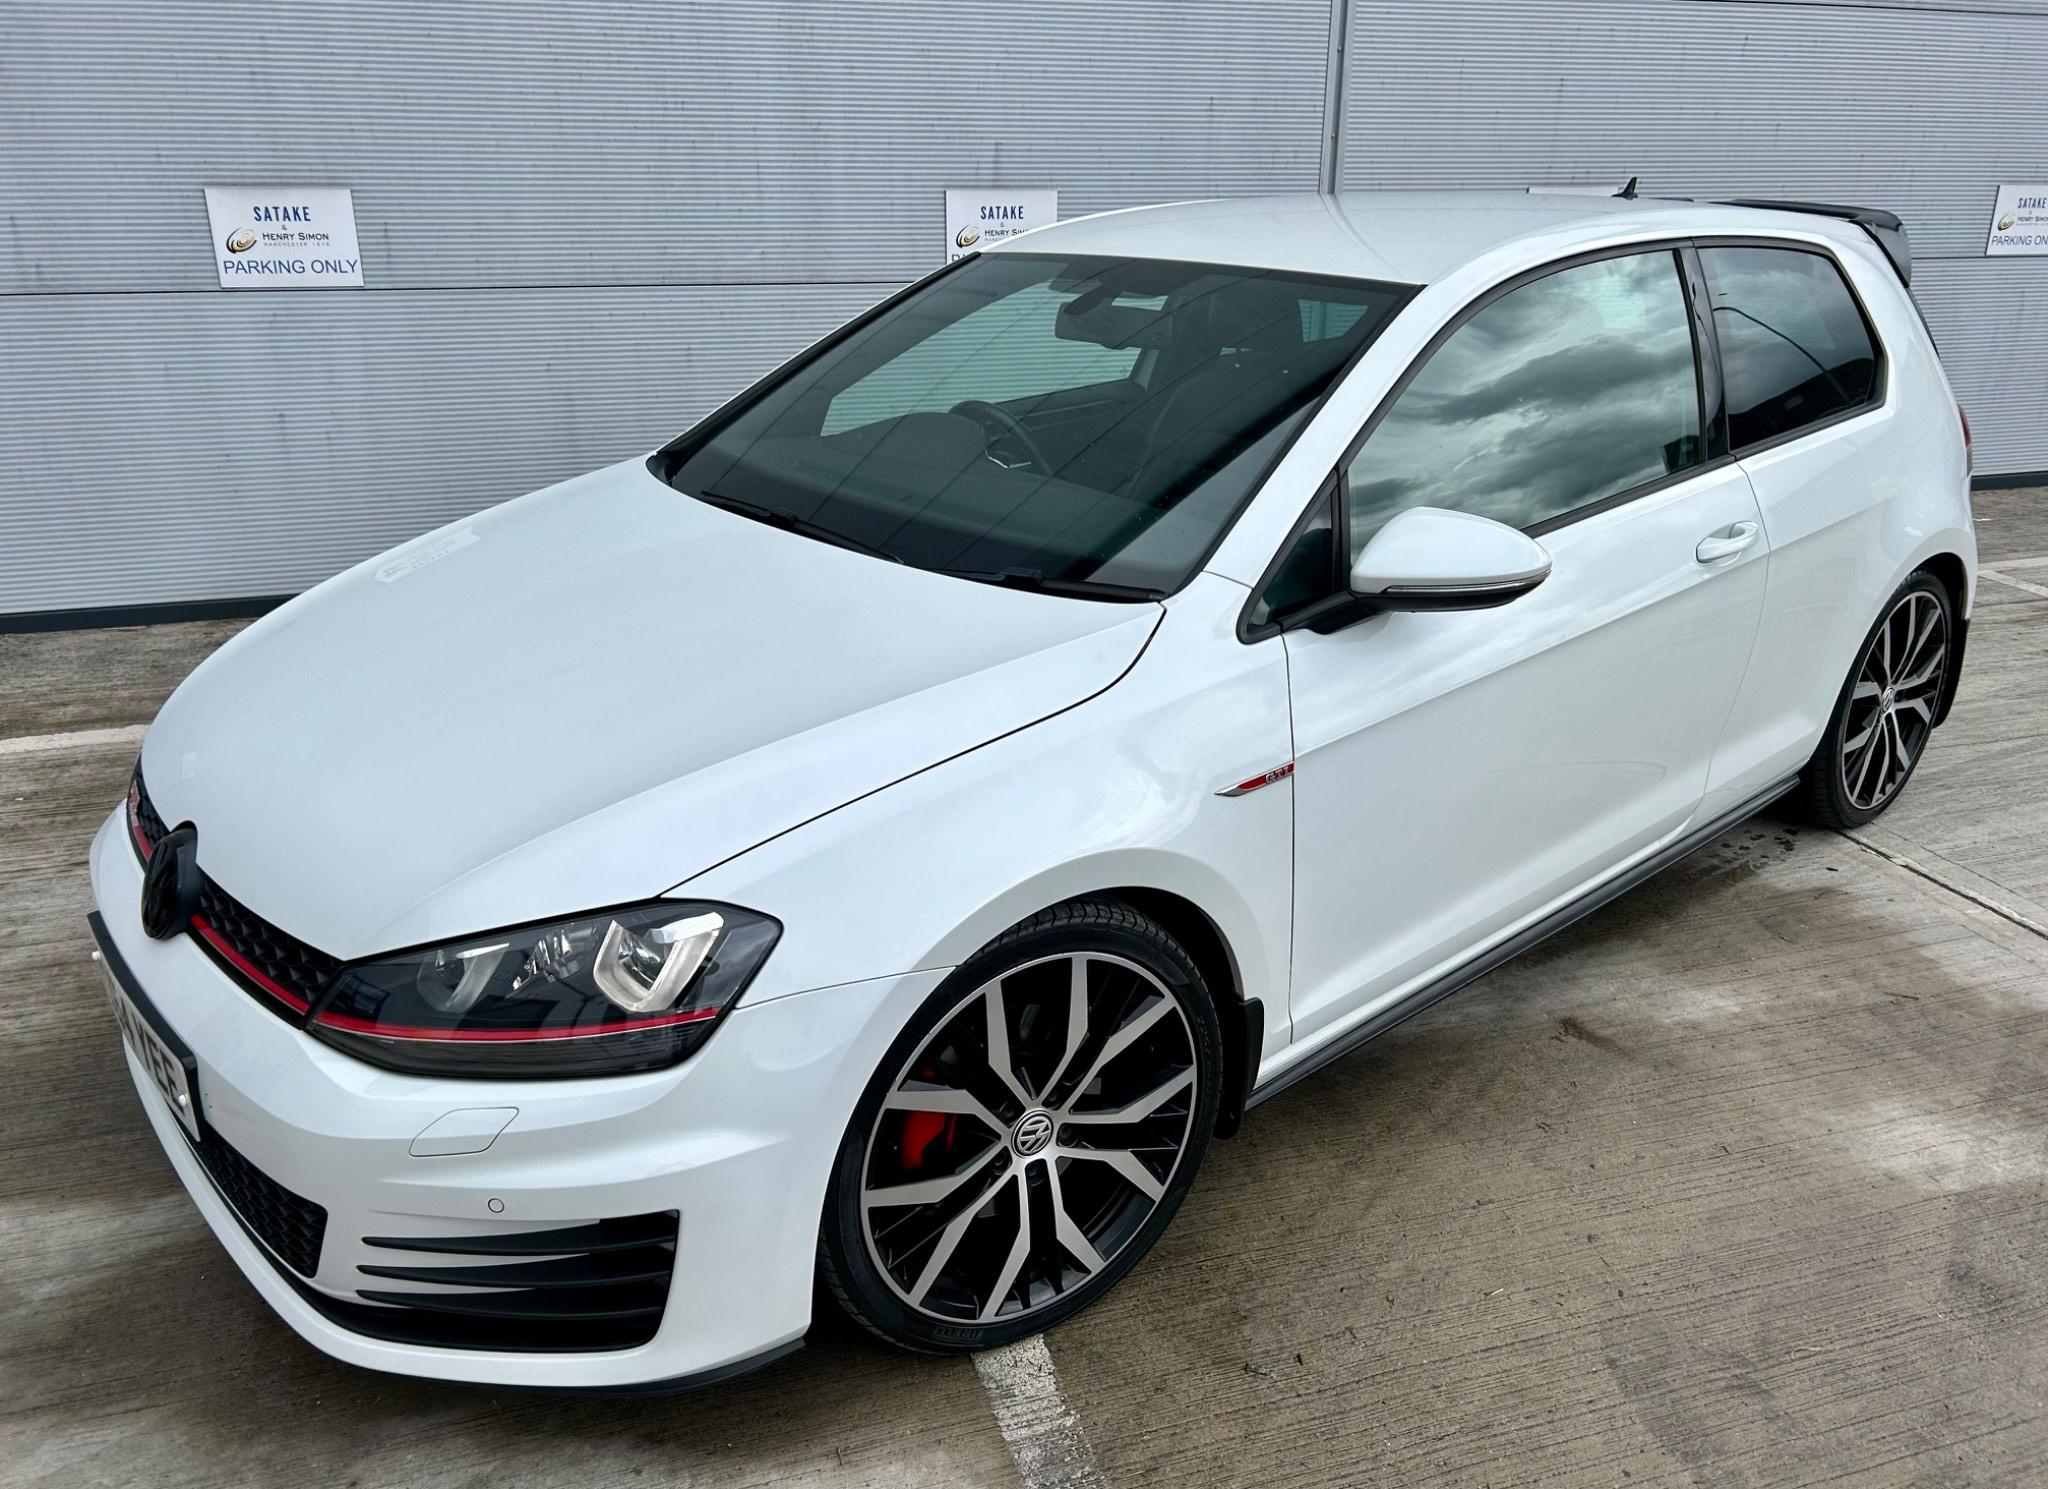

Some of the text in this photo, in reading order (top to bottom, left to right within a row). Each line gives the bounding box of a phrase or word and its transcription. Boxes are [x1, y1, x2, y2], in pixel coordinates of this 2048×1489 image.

[2018, 197, 2047, 209] SATAKE
[253, 206, 311, 222] SATAKE
[980, 206, 1024, 220] SATAKE
[262, 232, 329, 241] HENRY SIMON
[984, 229, 1010, 237] HENRY
[1991, 235, 2048, 246] PARKING ON
[223, 259, 358, 275] PARKING ONLY
